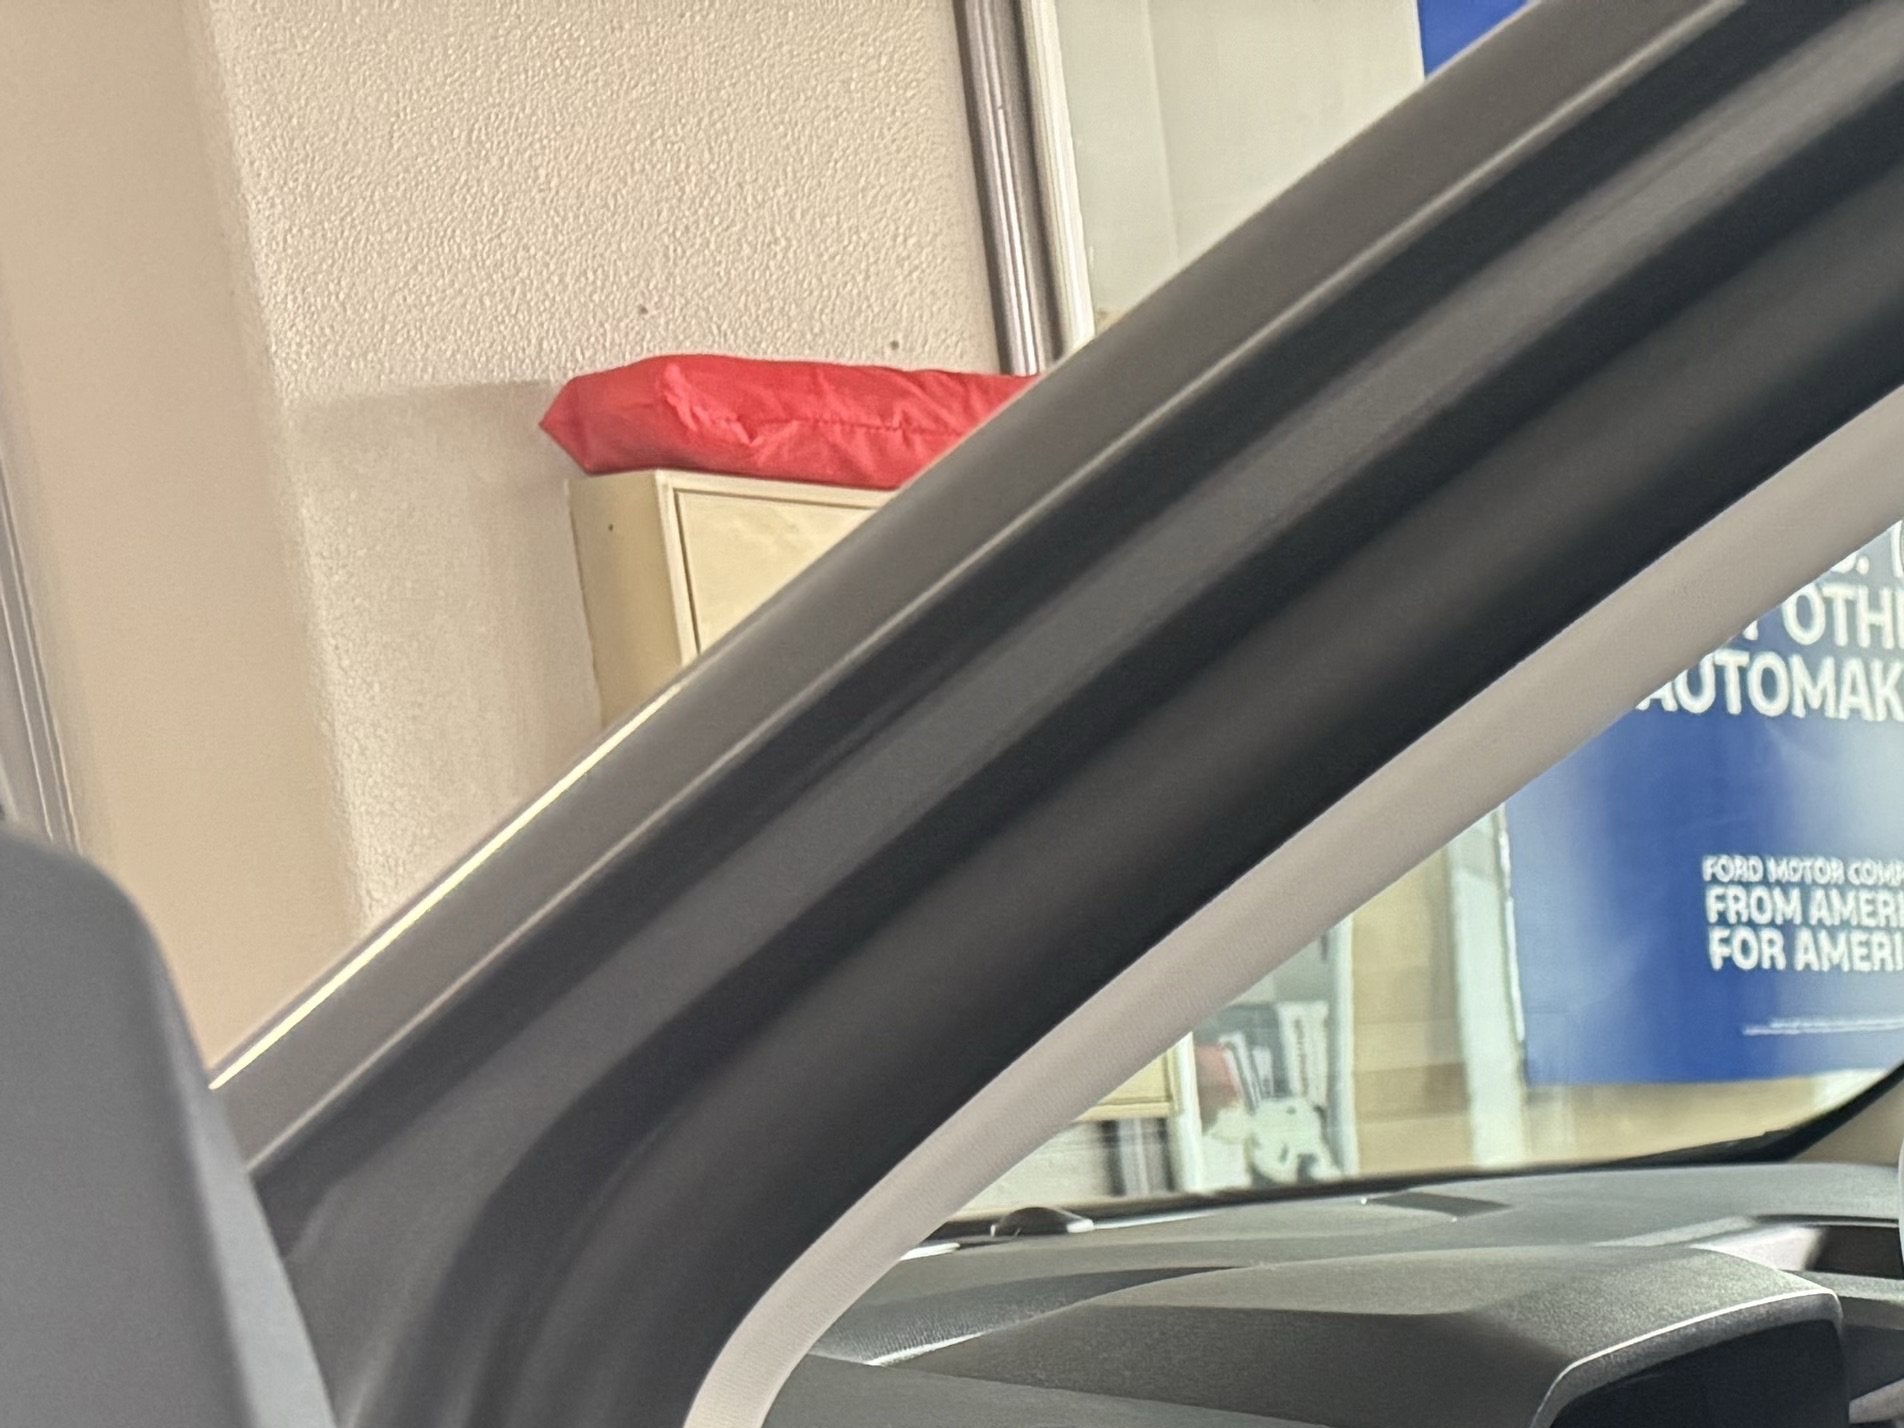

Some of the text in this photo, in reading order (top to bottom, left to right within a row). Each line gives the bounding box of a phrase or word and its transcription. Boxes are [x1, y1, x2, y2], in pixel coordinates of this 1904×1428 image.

[1703, 854, 1764, 883] FORD
[1767, 856, 1844, 885] MOTOR
[1706, 884, 1801, 925] FROM
[1709, 925, 1787, 970] FOR
